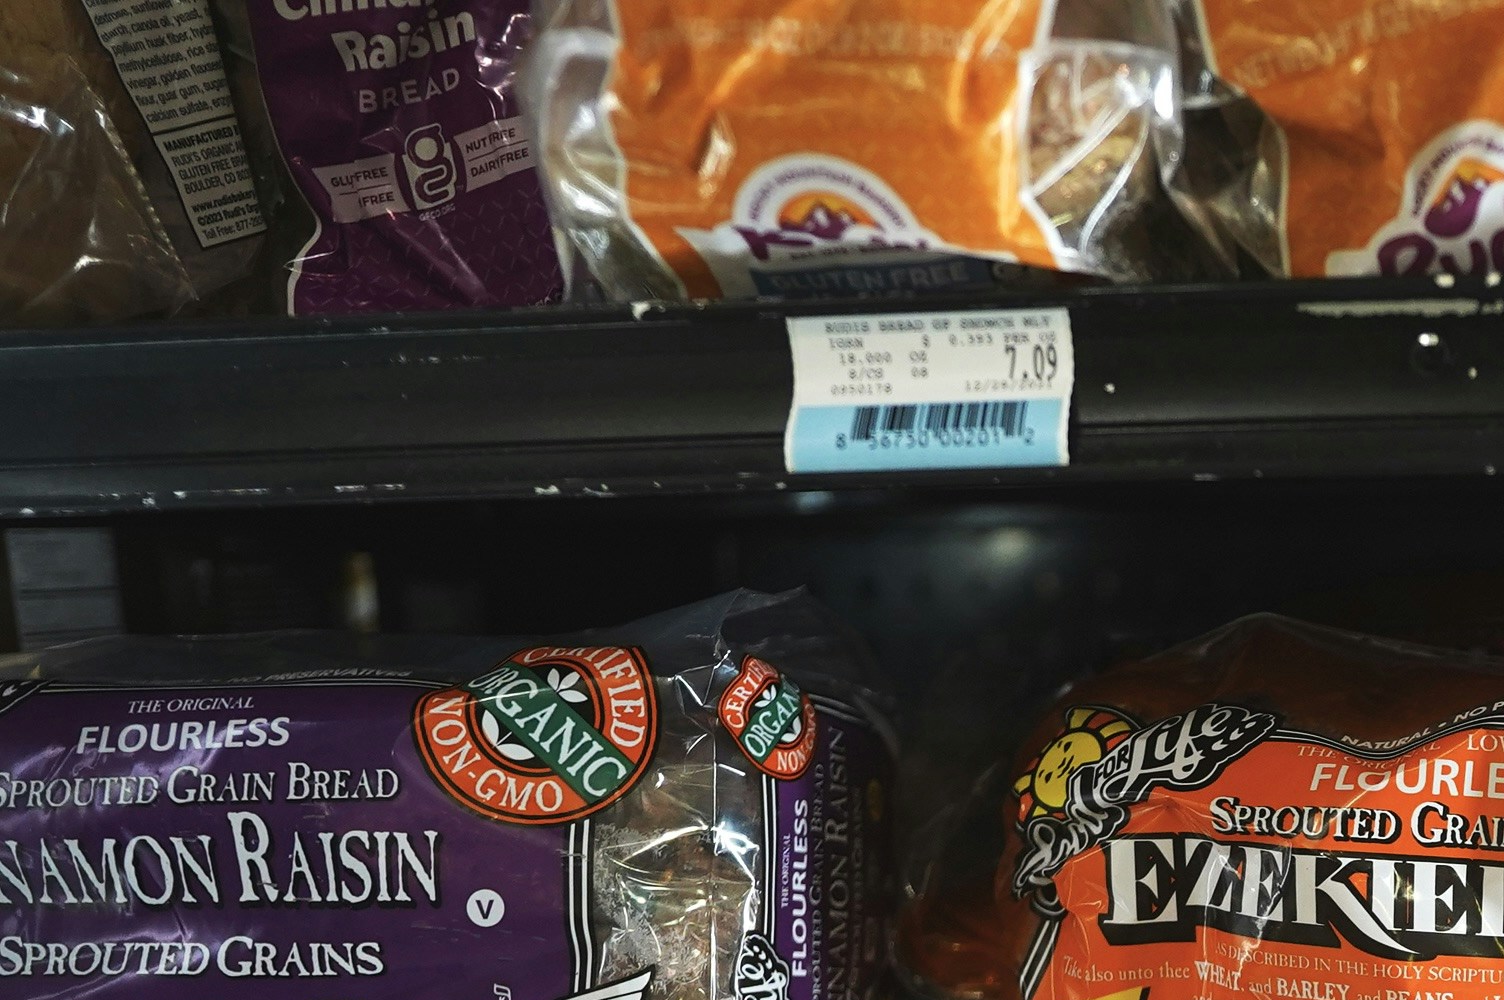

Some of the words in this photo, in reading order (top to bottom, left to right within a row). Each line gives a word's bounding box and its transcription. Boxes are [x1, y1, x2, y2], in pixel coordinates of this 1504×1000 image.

[331, 8, 476, 72] Raisin
[358, 68, 461, 114] BREAD
[163, 126, 233, 152] MANUFACTURED
[464, 133, 487, 154] NUT
[498, 147, 530, 165] FREE
[178, 163, 211, 181] GLUTEN
[211, 159, 232, 173] FREE
[183, 176, 225, 195] BOULDER,
[1004, 344, 1058, 381] 7.09
[127, 699, 163, 714] THE
[165, 695, 255, 713] ORIGINAL
[522, 646, 647, 748] CERTIFIED
[1454, 705, 1486, 722] NO
[76, 716, 291, 754] FLOURLESS
[467, 668, 628, 797] ORGANIC
[427, 694, 564, 813] NON-GMO
[1094, 744, 1129, 788] FOR
[167, 766, 275, 804] GRAIN
[286, 762, 399, 801] BREAD
[1209, 796, 1398, 841] SPROUTED
[227, 811, 438, 902] RAISIN
[791, 799, 809, 978] FLOURLESS
[217, 936, 385, 976] GRAINS
[1372, 963, 1424, 979] HOLY
